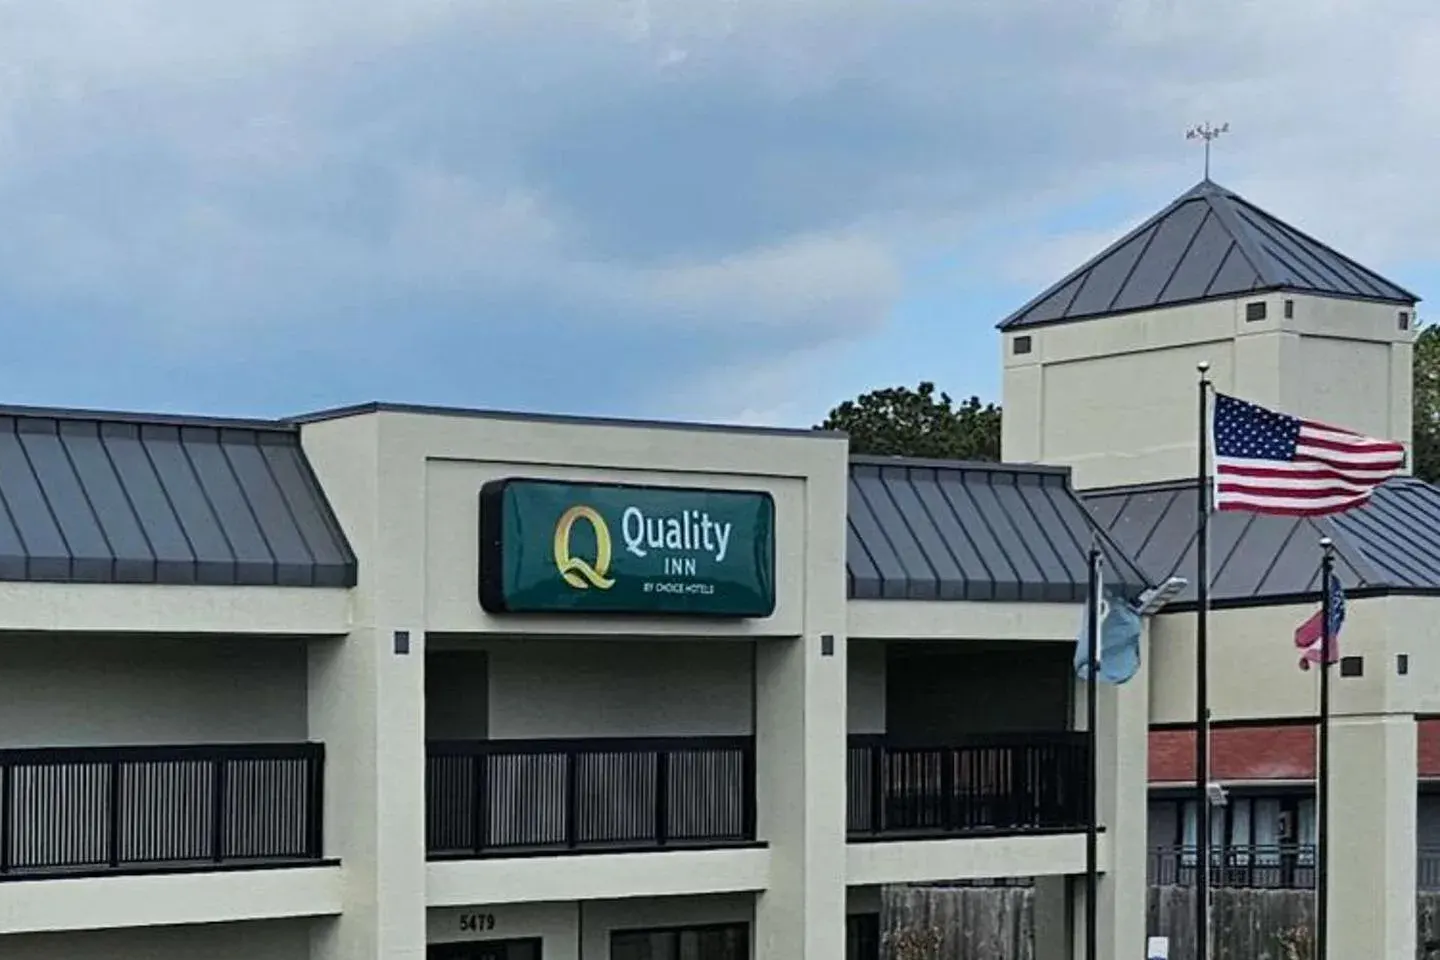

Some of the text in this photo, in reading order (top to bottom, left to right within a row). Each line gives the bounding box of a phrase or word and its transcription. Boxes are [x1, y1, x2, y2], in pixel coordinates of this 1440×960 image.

[622, 506, 731, 562] Quality
[554, 506, 615, 589] Q
[664, 557, 696, 576] INN
[643, 582, 654, 593] BY
[656, 582, 683, 594] CHOICE
[460, 913, 495, 932] 5479
